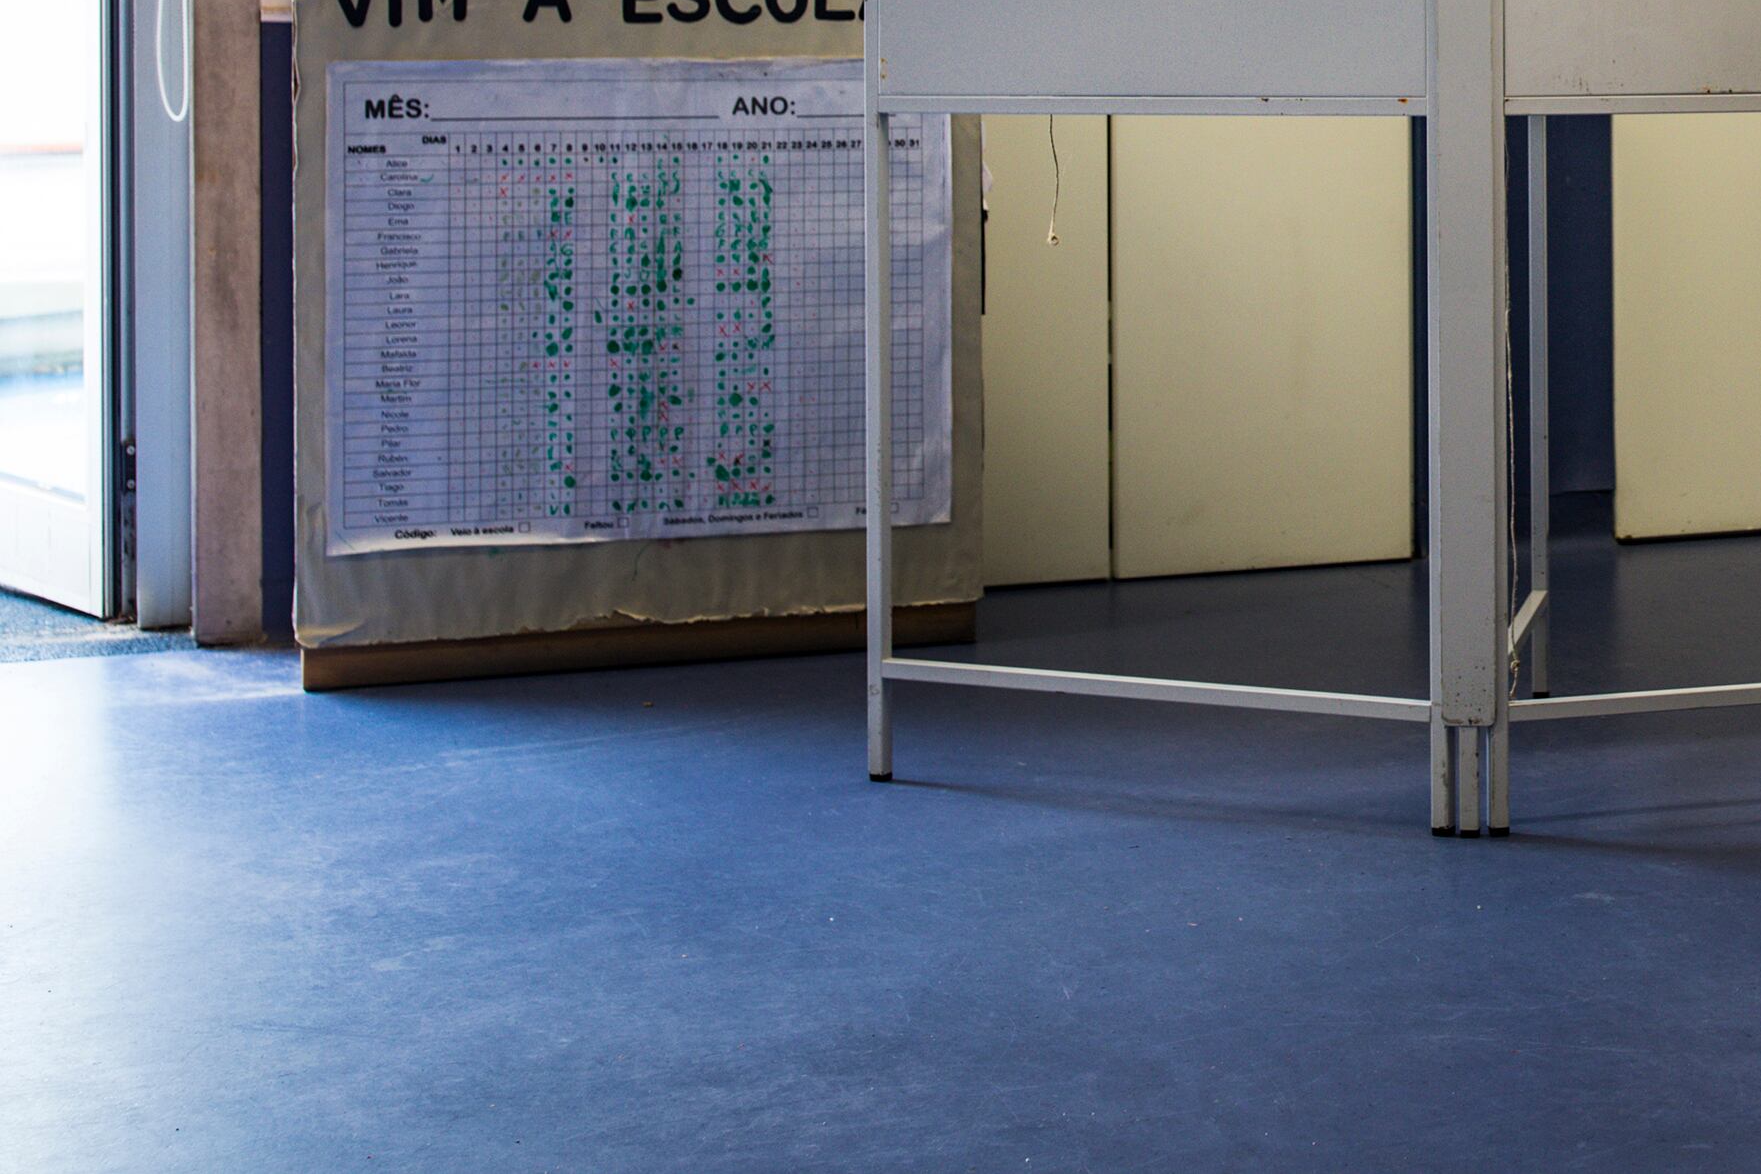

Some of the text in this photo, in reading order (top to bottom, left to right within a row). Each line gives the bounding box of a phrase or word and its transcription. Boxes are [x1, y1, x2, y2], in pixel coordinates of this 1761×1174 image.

[364, 94, 796, 120] MÊS: ANO:
[422, 135, 447, 145] DIAS
[347, 145, 387, 154] NOMES
[456, 144, 460, 153] 1
[471, 144, 478, 153] 2
[486, 144, 493, 153] 3
[502, 143, 509, 152] 4
[550, 143, 558, 152] 7
[594, 142, 606, 151] 10
[610, 142, 620, 151] 11
[625, 142, 637, 151] 12
[640, 142, 653, 151] 13
[656, 142, 668, 151] 14
[702, 141, 713, 150] 17
[716, 141, 728, 150] 18
[732, 141, 744, 150] 19
[746, 140, 758, 149] 20
[761, 140, 773, 149] 21
[776, 140, 788, 149] 22
[791, 140, 802, 149] 23
[806, 140, 818, 149] 24
[850, 139, 862, 148] 27
[894, 139, 906, 148] 30
[908, 139, 920, 148] 31
[386, 159, 408, 167] Alice
[380, 172, 418, 181] Carolina
[387, 188, 412, 197] Clara
[387, 306, 413, 314] Laura
[394, 528, 436, 540] Código:
